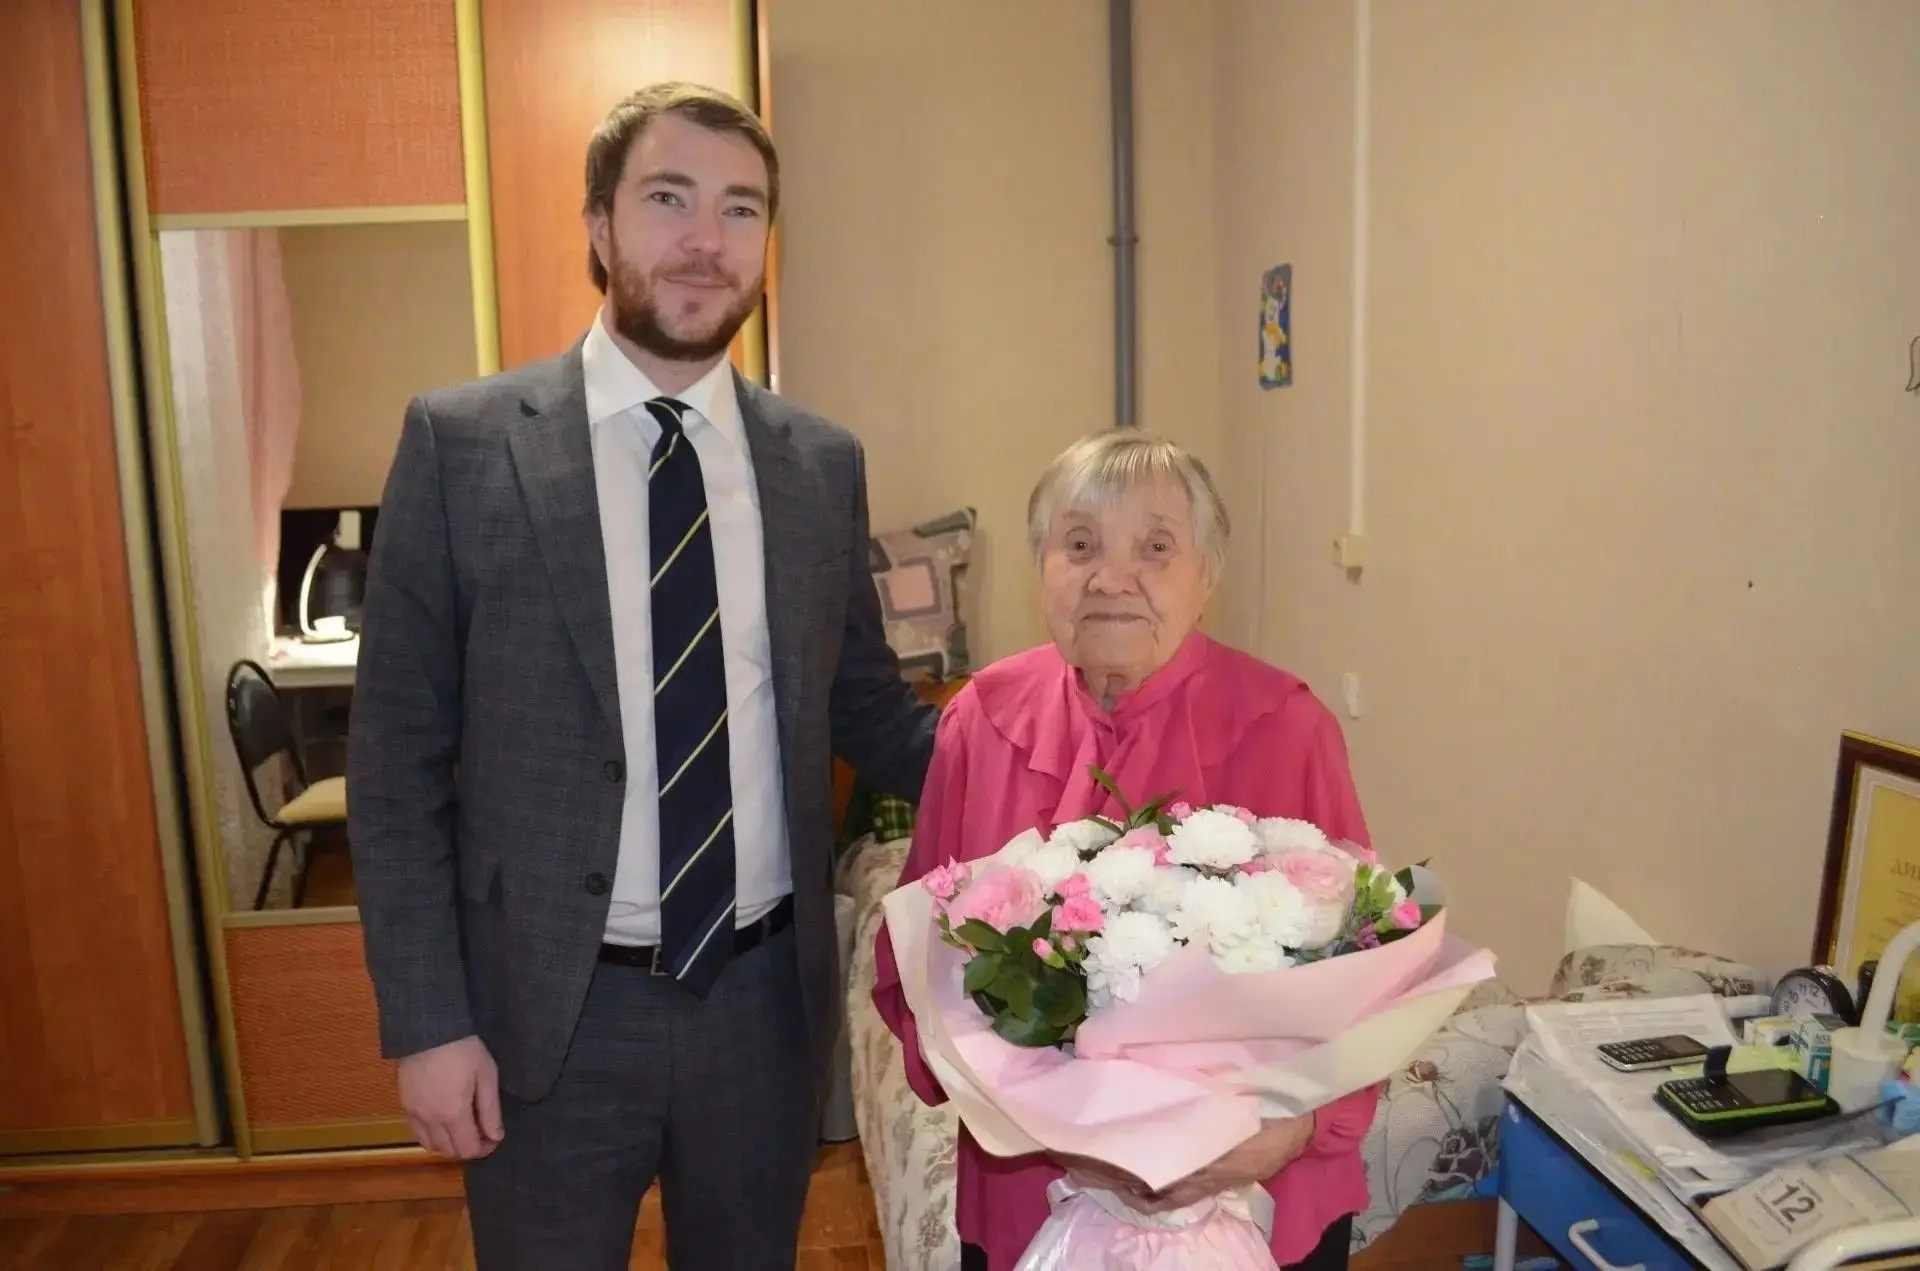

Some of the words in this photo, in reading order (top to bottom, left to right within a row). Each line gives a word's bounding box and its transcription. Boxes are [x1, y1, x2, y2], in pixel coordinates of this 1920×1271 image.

[1788, 990, 1799, 1004] 10
[1808, 983, 1820, 998] 12
[1770, 1184, 1816, 1223] 12
